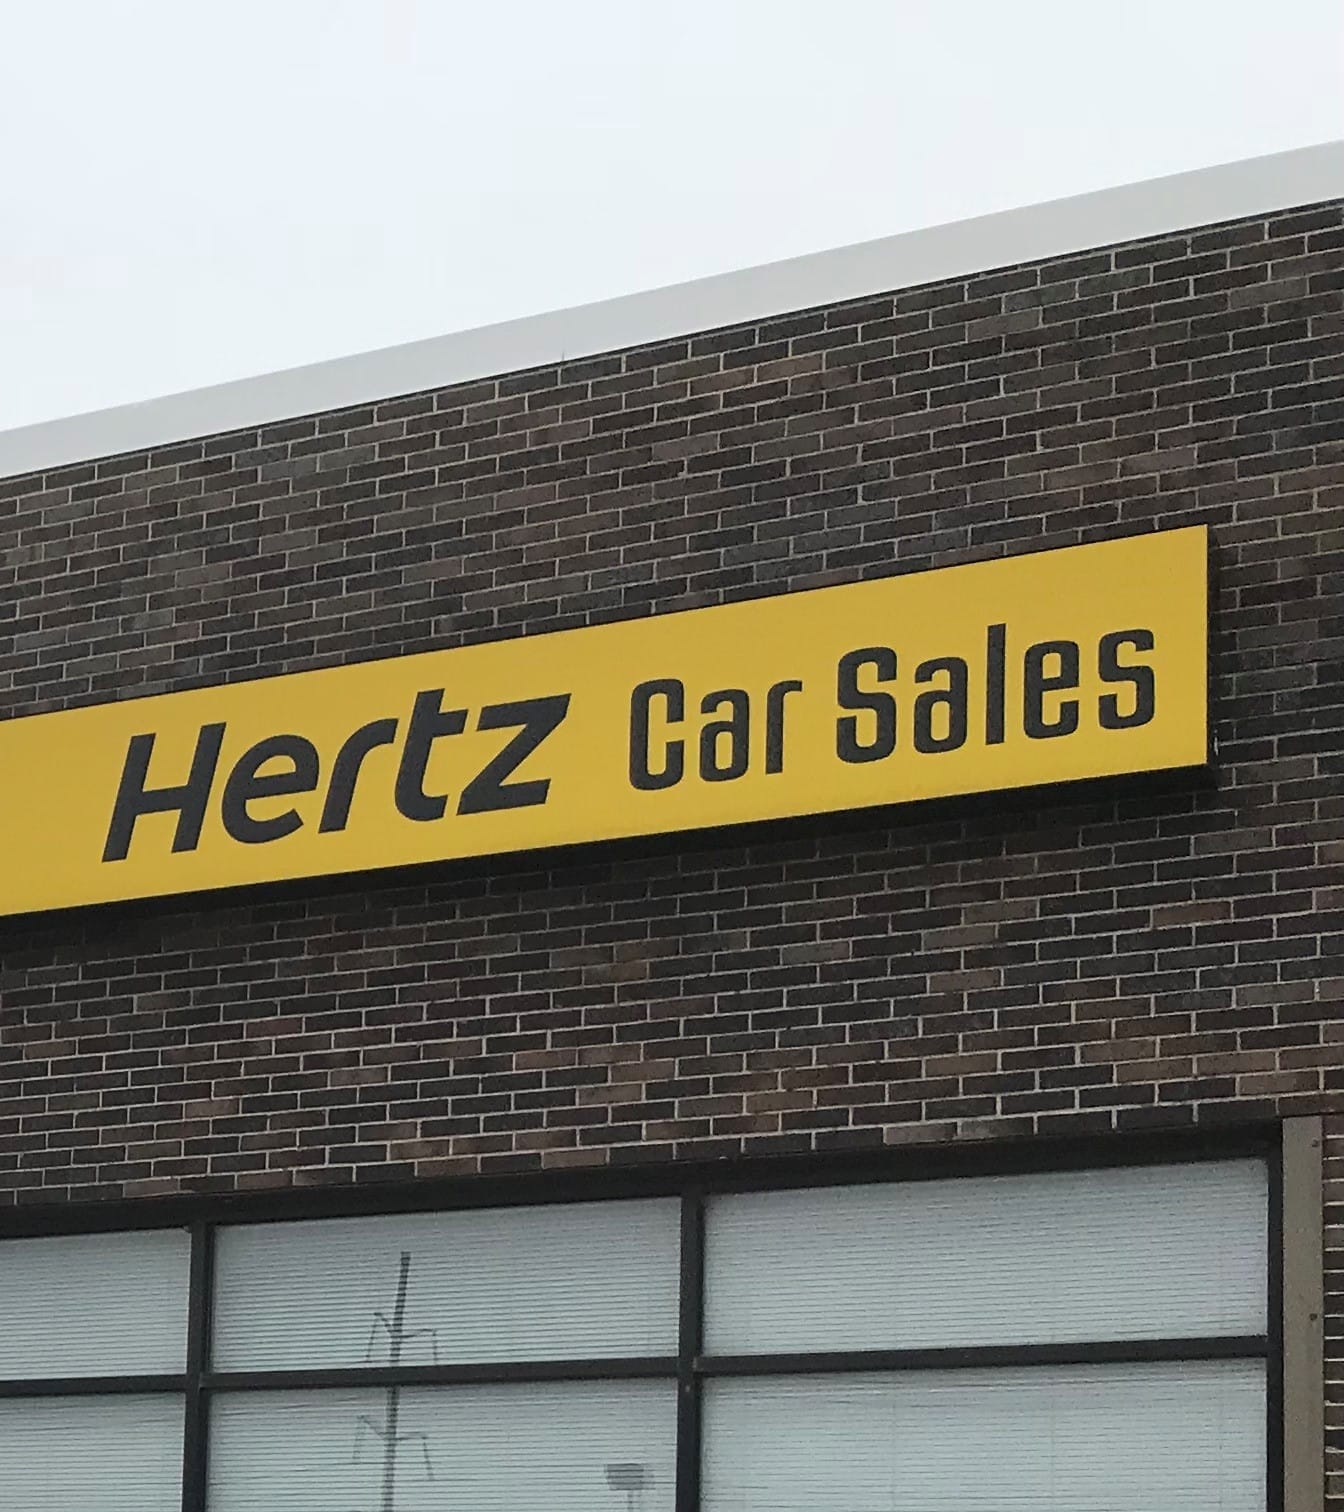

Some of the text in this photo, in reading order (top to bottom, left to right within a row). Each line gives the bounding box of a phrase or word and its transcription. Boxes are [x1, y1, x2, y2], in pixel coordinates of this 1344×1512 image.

[102, 623, 1155, 862] Hertz Car Sales
